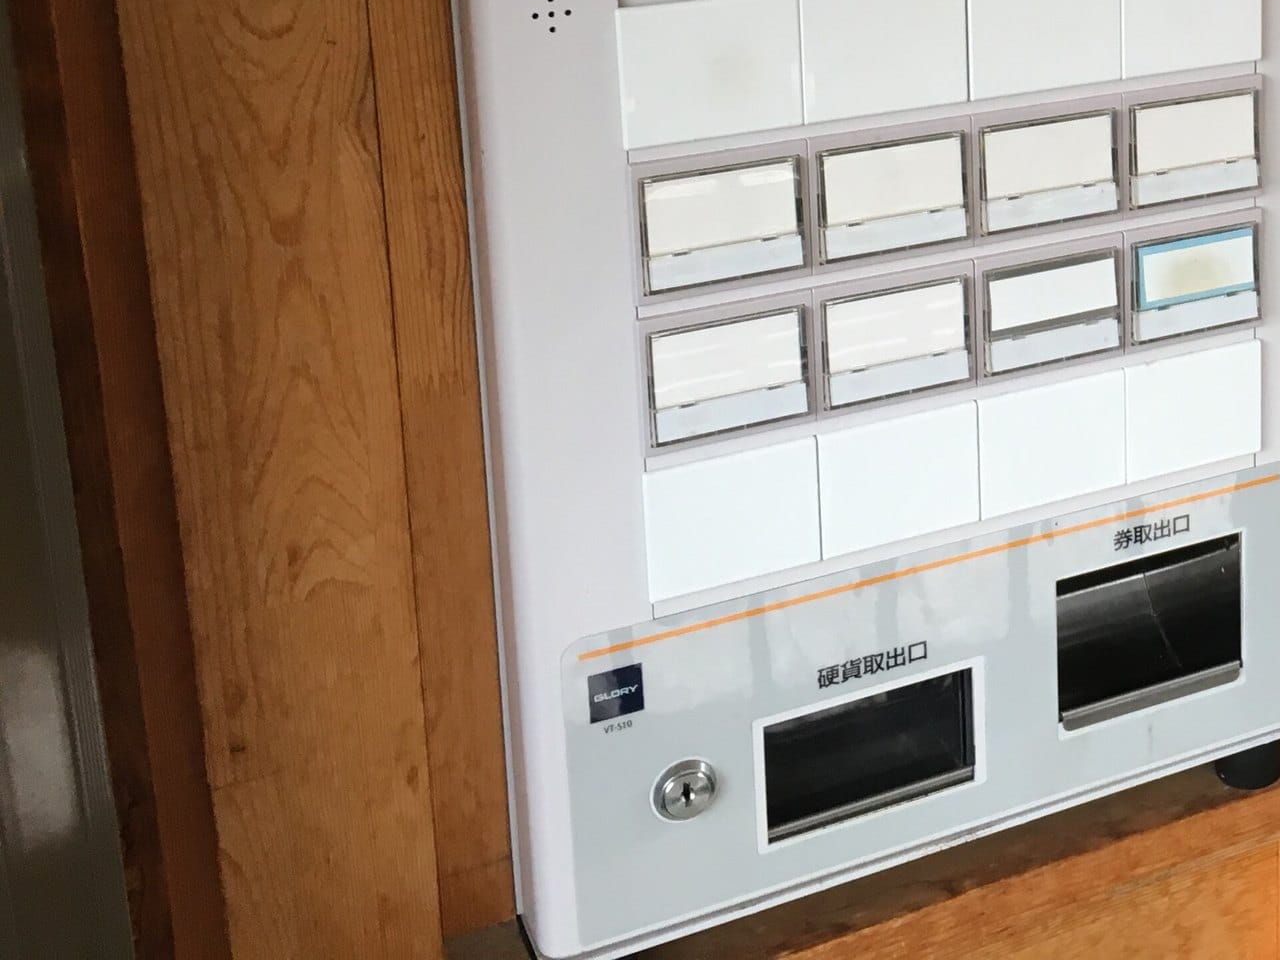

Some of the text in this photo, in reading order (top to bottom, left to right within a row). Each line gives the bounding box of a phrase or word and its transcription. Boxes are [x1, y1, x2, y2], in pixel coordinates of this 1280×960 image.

[1112, 514, 1192, 552] 券取出口
[816, 640, 929, 691] 硬貨取出口
[593, 684, 639, 703] GLORY
